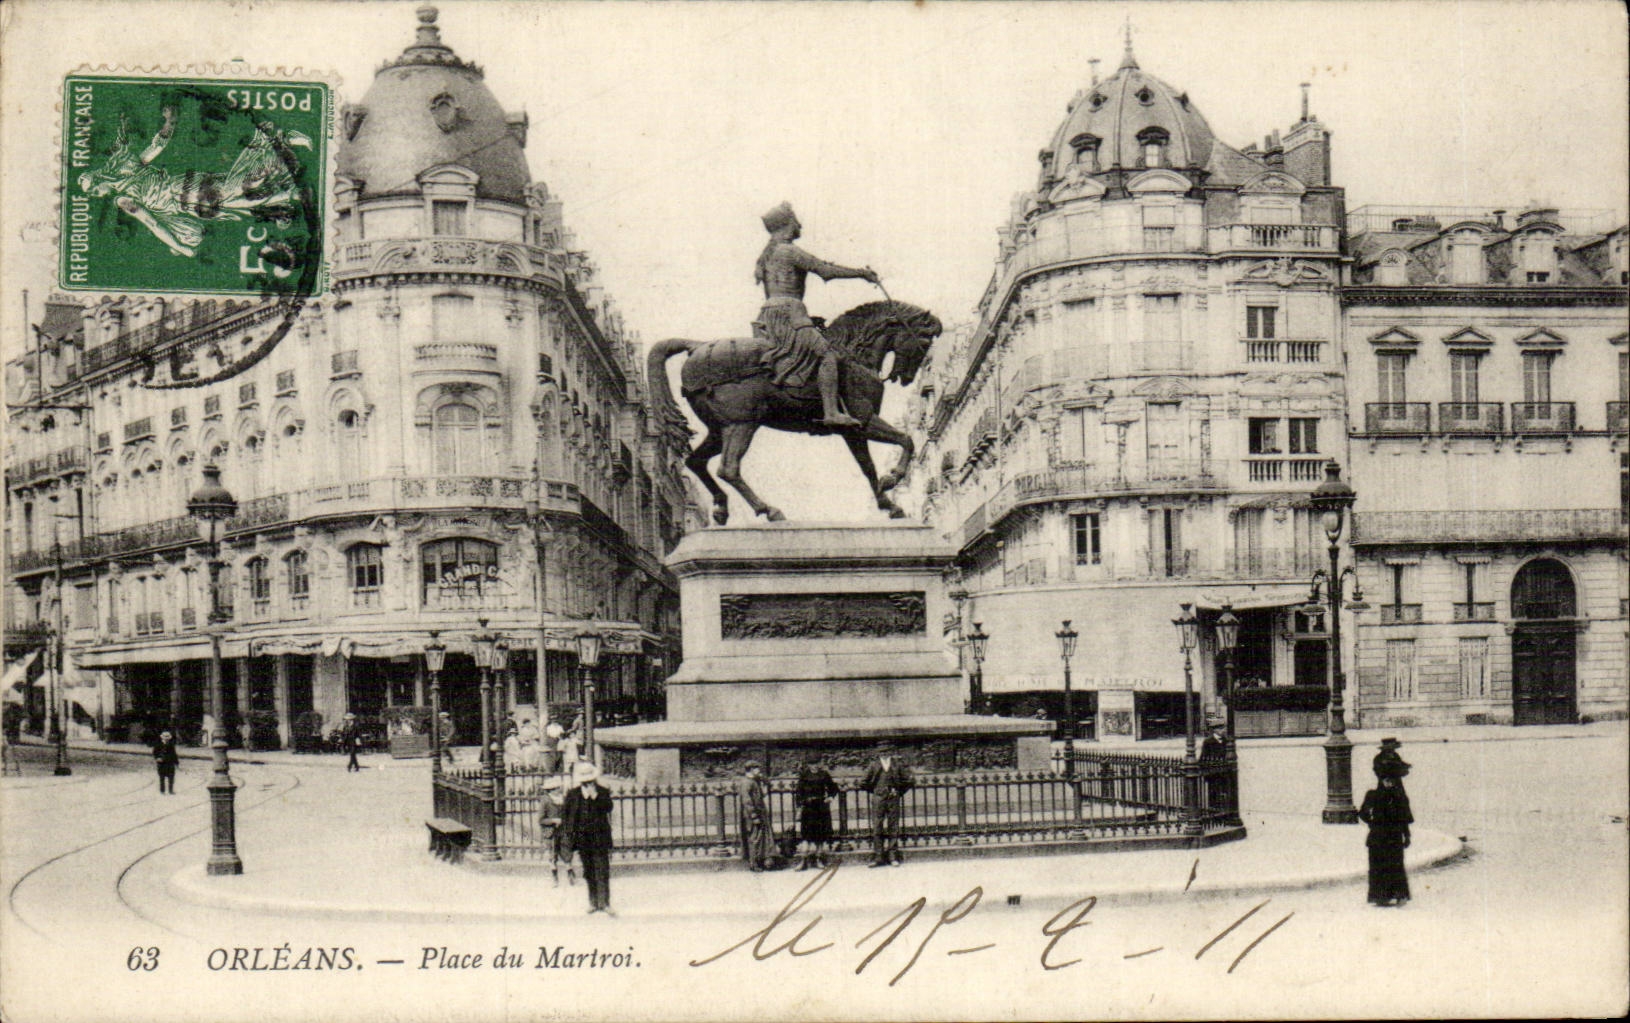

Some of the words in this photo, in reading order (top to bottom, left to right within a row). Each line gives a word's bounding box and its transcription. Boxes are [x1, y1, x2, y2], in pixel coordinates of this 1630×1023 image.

[227, 90, 312, 112] POSTES
[72, 85, 94, 168] FRANÇAISE
[440, 563, 481, 588] GRAND
